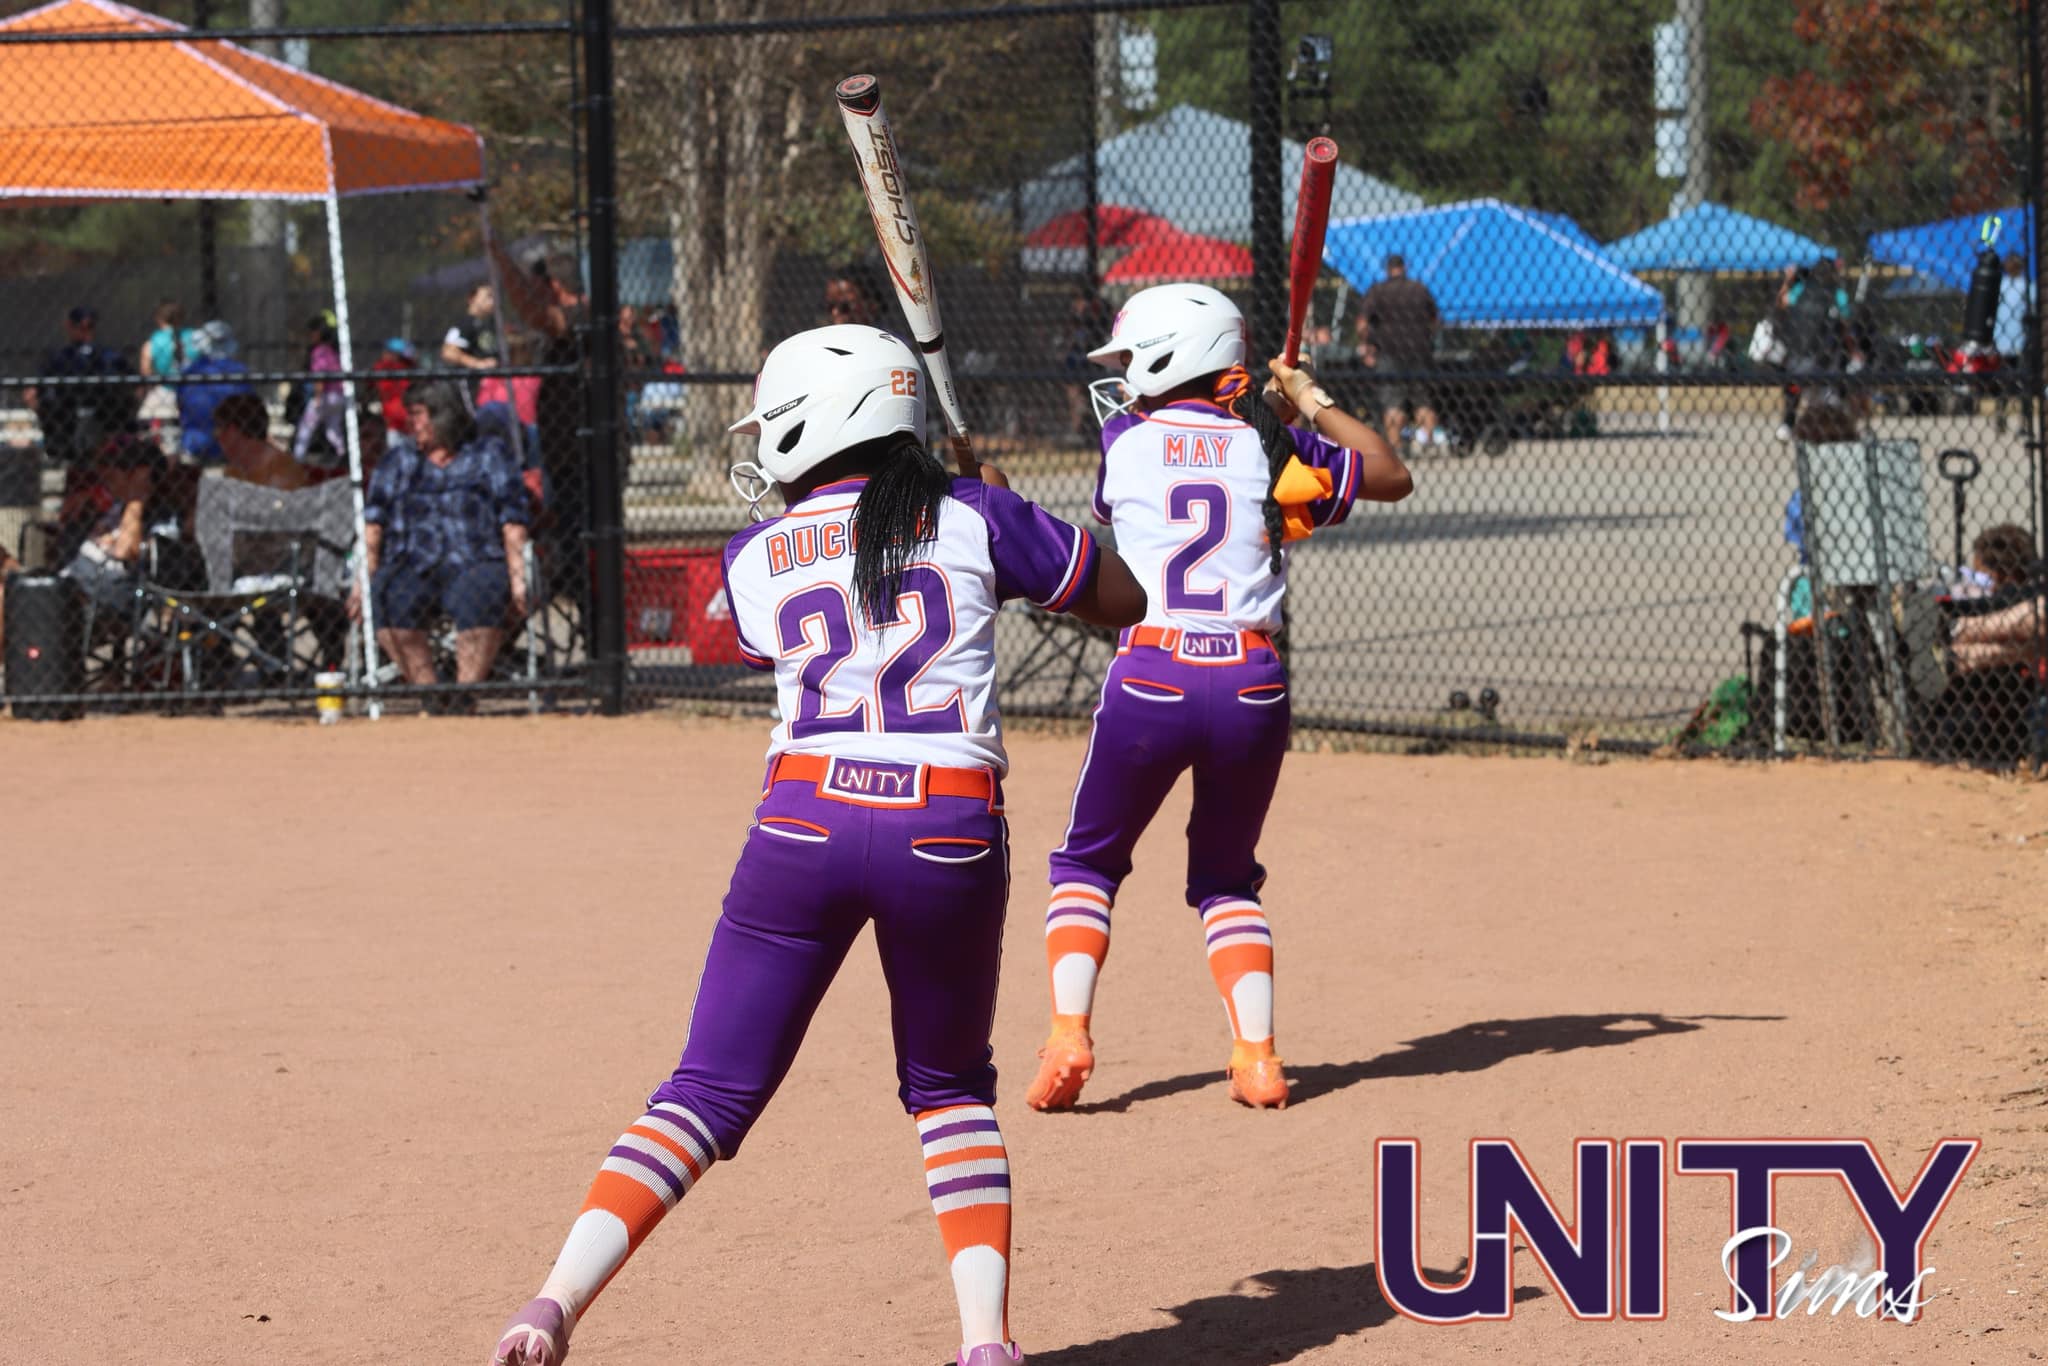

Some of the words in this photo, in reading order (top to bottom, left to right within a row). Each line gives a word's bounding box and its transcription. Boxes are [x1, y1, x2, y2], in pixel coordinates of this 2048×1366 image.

[867, 123, 917, 245] GHOST
[891, 370, 917, 397] 22
[766, 399, 799, 419] EASTON
[1163, 434, 1232, 467] MAY
[1163, 480, 1231, 616] 2
[775, 562, 969, 740] 22
[1184, 636, 1236, 656] UNITY
[836, 767, 912, 794] UNITY
